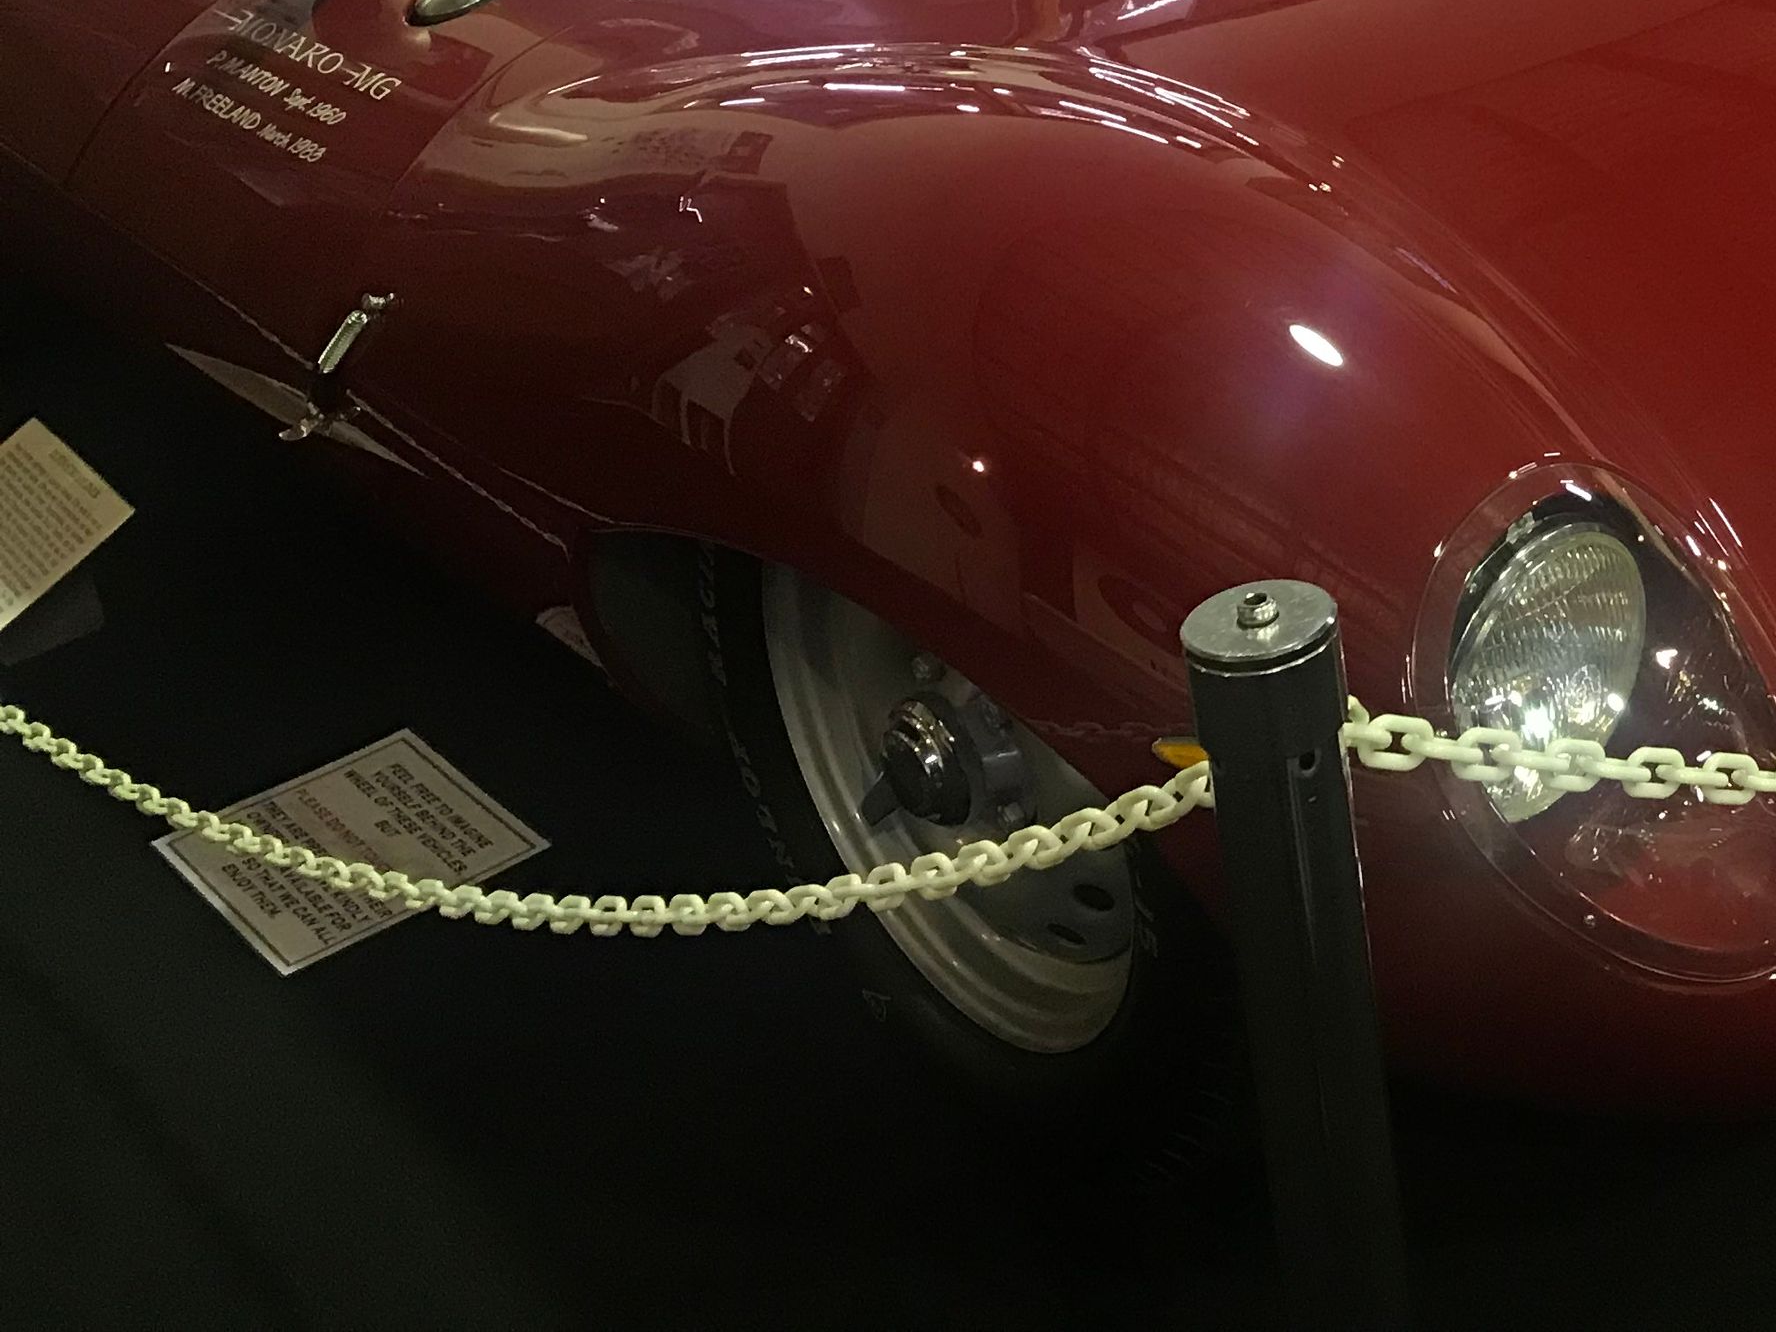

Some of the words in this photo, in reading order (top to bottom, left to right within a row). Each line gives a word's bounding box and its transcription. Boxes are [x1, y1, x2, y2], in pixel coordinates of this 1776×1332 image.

[307, 102, 347, 126] 1960
[260, 800, 293, 824] THEY
[281, 819, 309, 840] ARE
[291, 787, 334, 820] PLEASE
[323, 816, 345, 831] DO
[337, 828, 366, 849] NOT
[340, 768, 380, 798] WHEEL
[371, 794, 394, 810] OF
[384, 805, 424, 836] THESE
[368, 769, 424, 813] YOURSELF
[412, 807, 459, 842] BEHIND
[448, 837, 477, 858] THE
[372, 818, 403, 839] BUT
[384, 761, 417, 785] FEEL
[407, 781, 443, 806] FREE
[433, 802, 455, 817] TO
[444, 812, 495, 850] IMAGINE
[218, 861, 258, 893] ENJOY
[239, 855, 263, 872] SO
[252, 868, 286, 894] THAT
[276, 891, 301, 908] WE
[290, 904, 321, 928] CAN
[309, 923, 339, 946] ALL
[274, 864, 334, 914] AVAILABLE
[323, 910, 354, 933] FOR
[329, 890, 373, 925] KINDLY
